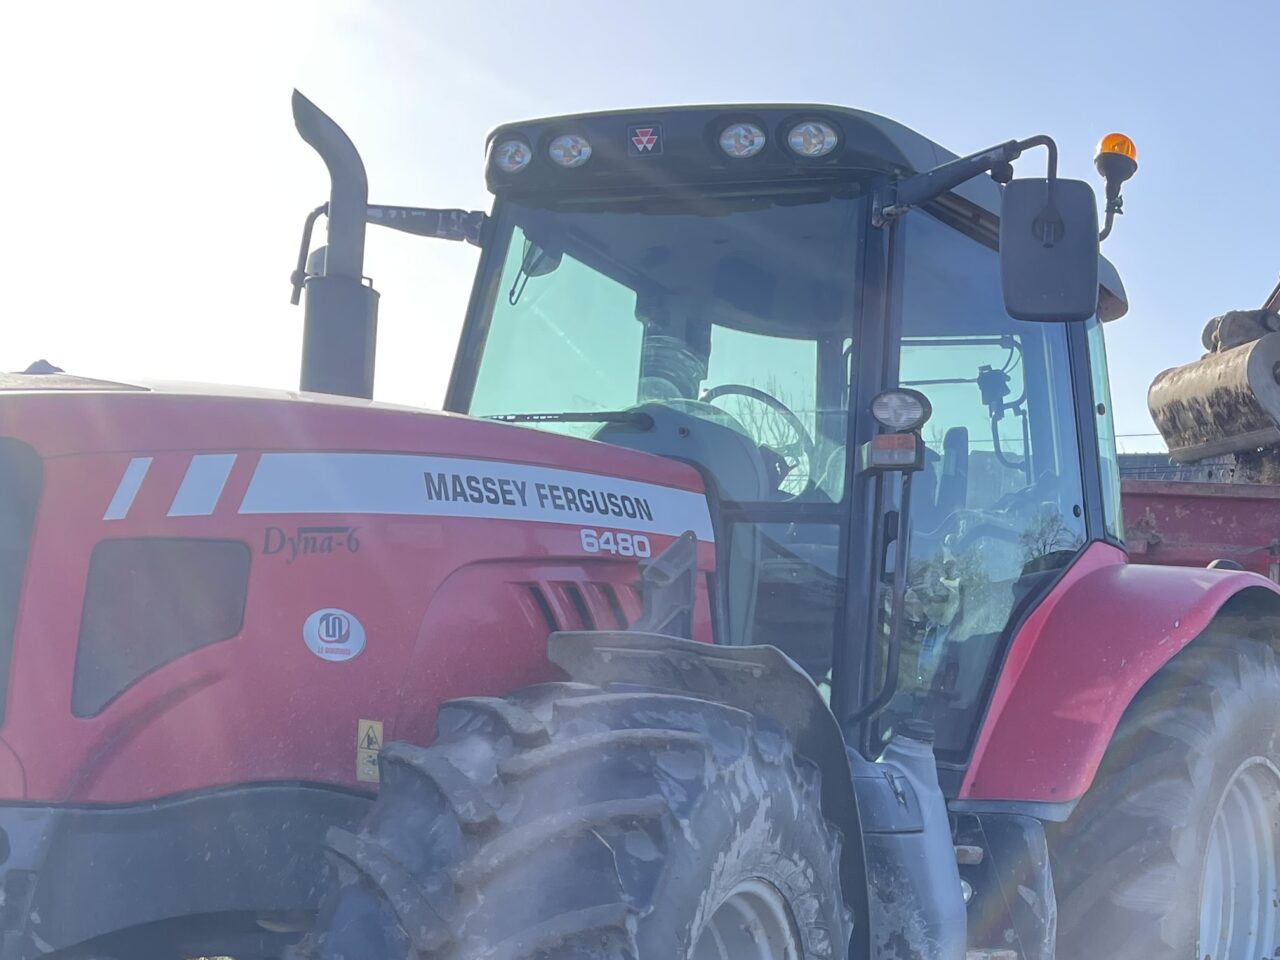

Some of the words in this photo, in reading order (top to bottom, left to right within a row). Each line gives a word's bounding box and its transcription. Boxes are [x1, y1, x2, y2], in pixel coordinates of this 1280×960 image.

[423, 472, 528, 507] MASSEY
[534, 482, 654, 522] FERGUSON
[263, 526, 362, 565] Dyna-6
[580, 528, 651, 558] 6480
